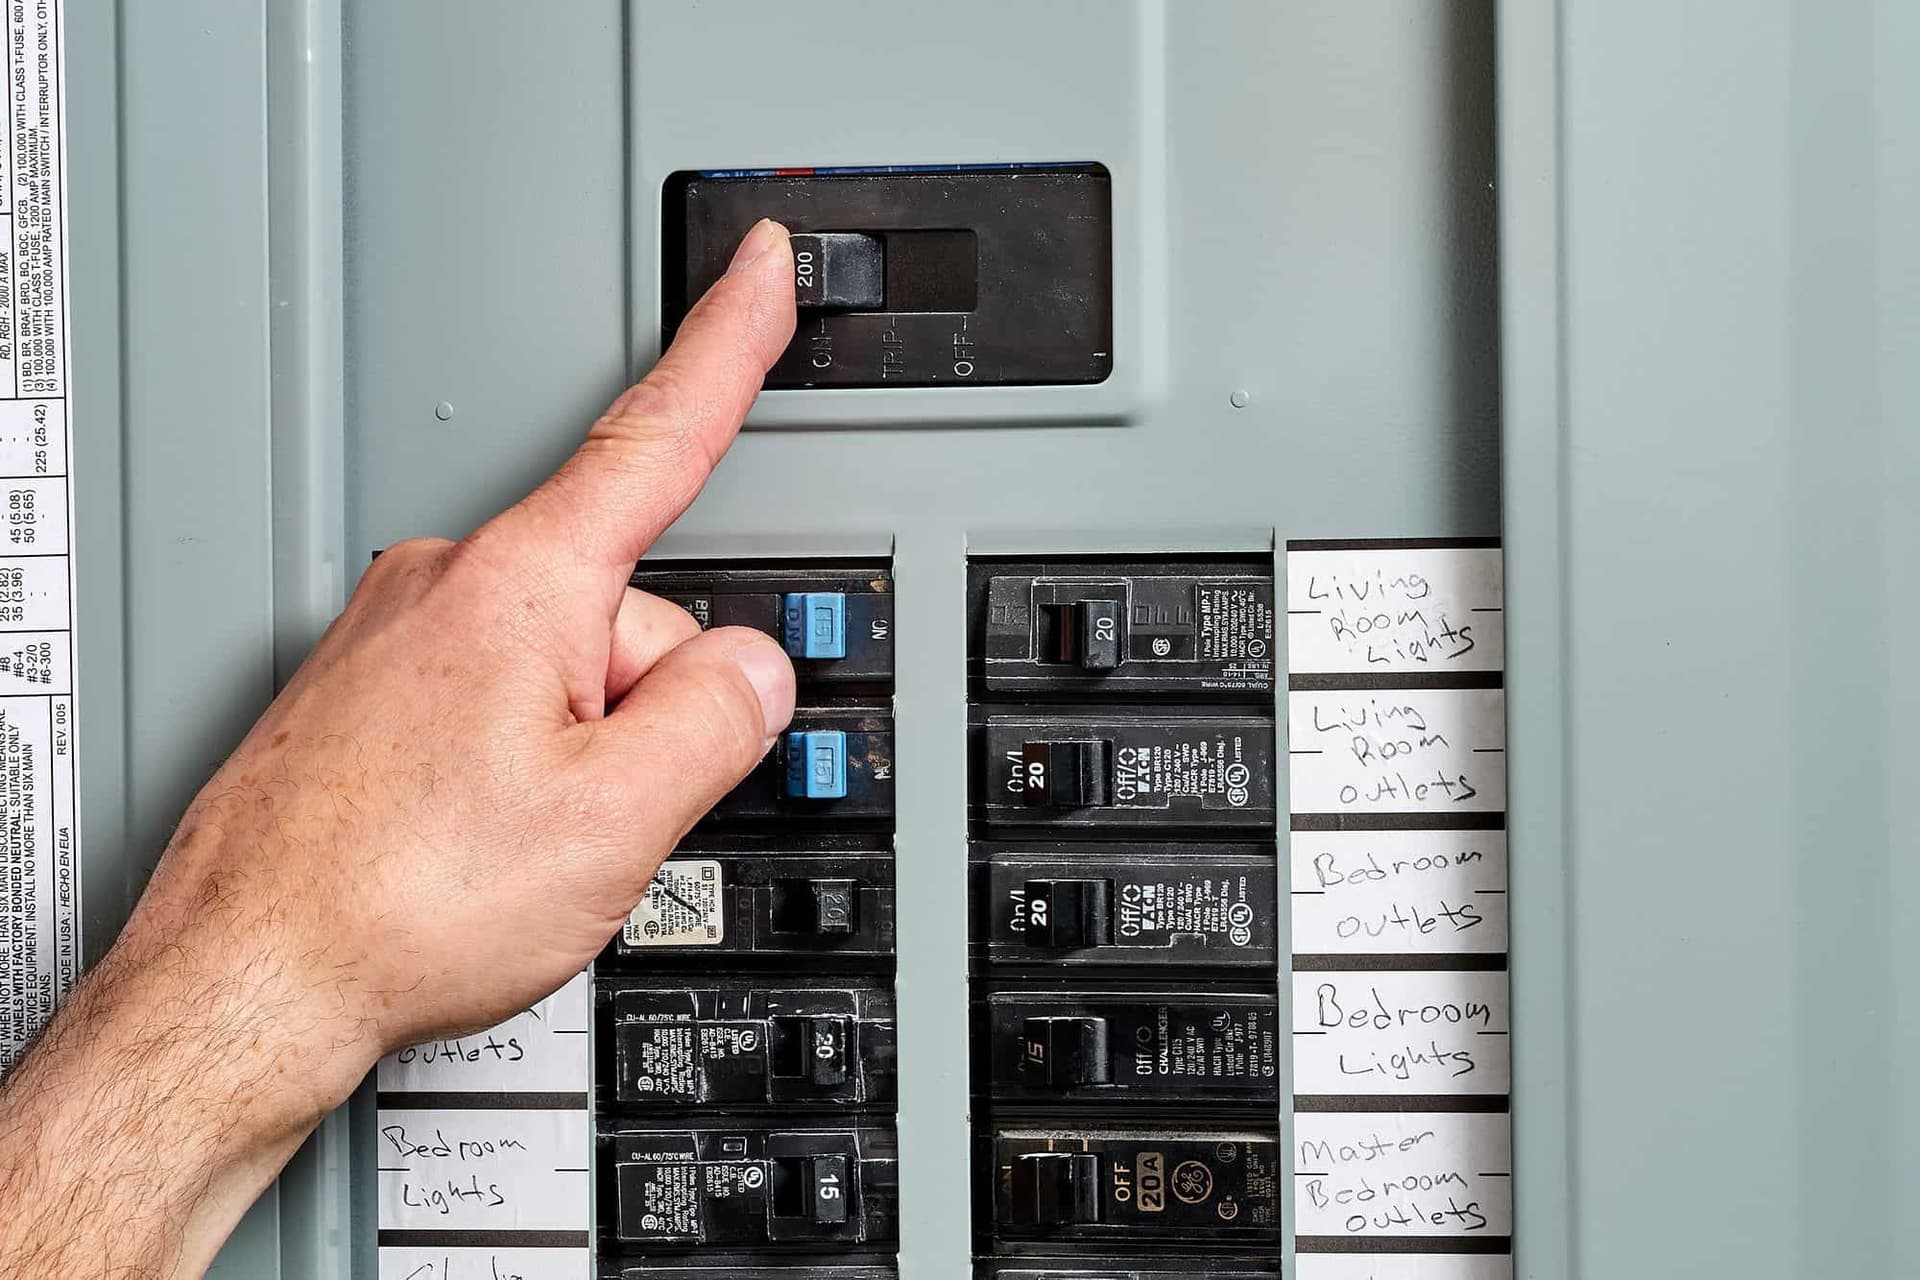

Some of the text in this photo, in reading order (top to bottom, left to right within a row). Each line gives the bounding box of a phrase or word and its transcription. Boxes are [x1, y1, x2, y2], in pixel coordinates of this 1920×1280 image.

[37, 22, 48, 50] ONLY,
[38, 54, 49, 128] INTERRUPTOR
[40, 136, 50, 176] SWITCH
[14, 6, 35, 392] (1) BD, BR, BRAF, BRD, BQ, BQC, GFCB. (2) 100,000 WITH CLASS T-FUSE, 600
[41, 179, 51, 206] MAIN
[42, 208, 52, 242] RATED
[28, 126, 44, 392] (3) 100,000 WITH CLASS T-FUSE, 1200 AMP MAXIMUM.
[42, 244, 52, 268] AMP
[796, 251, 814, 288] 200
[0, 286, 10, 308] 2000
[43, 270, 54, 306] 100,000
[0, 317, 10, 339] RGH
[44, 310, 54, 336] WITH
[45, 339, 56, 376] 100,000
[46, 379, 57, 392] (4)
[35, 404, 48, 473] 225 (25.42)
[10, 489, 24, 544] 45 (5.08)
[23, 488, 37, 544] 50 (5.65)
[0, 567, 11, 622] 25 (2.82)
[12, 567, 24, 621] 35 (3.96)
[1308, 569, 1433, 607] Living
[871, 620, 889, 640] ON
[1095, 616, 1116, 642] 20
[1202, 590, 1212, 638] Type MP-T
[1368, 616, 1475, 664] Lights
[0, 656, 10, 672] #8
[12, 650, 24, 677] #6-4
[26, 644, 38, 683] #3-2/0
[40, 642, 52, 684] #6-300
[56, 703, 66, 755] REV. 005
[1314, 699, 1427, 738] Living
[1028, 762, 1044, 789] 20
[1154, 746, 1162, 792] Type BR120
[1164, 749, 1172, 792] Type C120
[0, 774, 8, 863] DISCONNECTING
[0, 866, 8, 892] MAIN
[8, 724, 24, 1042] PANELS WITH FACTORY BONDED NEUTRAL: SUITABLE ONLY
[1312, 850, 1482, 889] Bedroom
[0, 895, 9, 912] SIX
[22, 744, 38, 1038] SERVICE EQUIPMENT. INSTALL NO MORE THAN SIX MAIN
[58, 826, 72, 992] MADE IN USA HECHO EN EUA
[1156, 883, 1164, 930] Type BR120
[1166, 886, 1174, 930] Type C120
[0, 916, 10, 943] THAN
[1030, 900, 1048, 926] 20
[0, 947, 10, 980] MORE
[0, 980, 10, 1004] NOT
[40, 972, 51, 1014] MEANS.
[1316, 982, 1490, 1031] Bedroom
[0, 1008, 11, 1040] WHEN
[1158, 1006, 1169, 1075] CHALLENGER
[816, 1032, 834, 1058] 20
[1028, 1040, 1044, 1064] 15
[1339, 1041, 1475, 1080] Lights
[1173, 1056, 1186, 1075] Type
[382, 1125, 528, 1161] Bedroom
[1299, 1129, 1434, 1166] Master
[403, 1174, 505, 1214] Lights
[819, 1174, 840, 1200] 15
[1114, 1161, 1130, 1203] OFF
[1305, 1171, 1468, 1208] Bedroom
